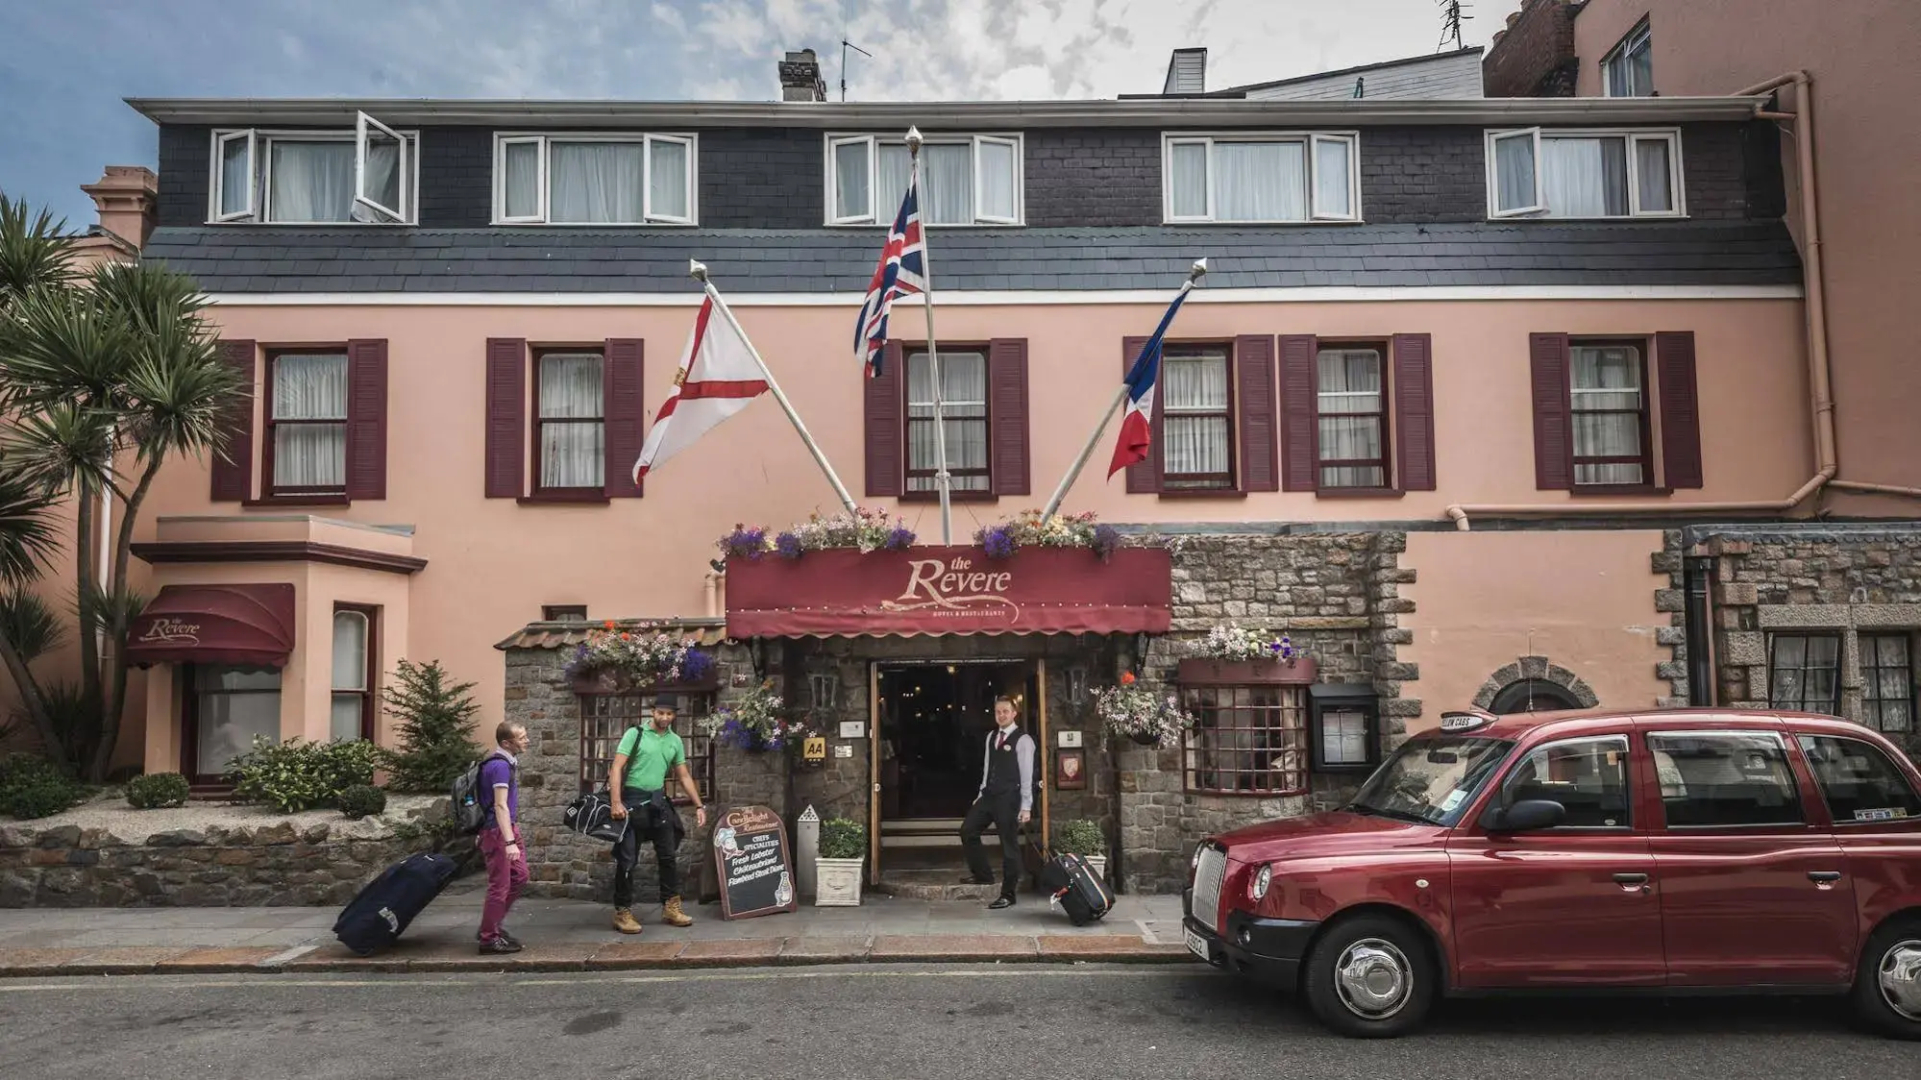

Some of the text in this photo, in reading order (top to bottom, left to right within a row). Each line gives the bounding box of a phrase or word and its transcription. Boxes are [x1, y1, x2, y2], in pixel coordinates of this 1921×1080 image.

[951, 556, 972, 570] the
[897, 559, 1012, 609] Revere
[145, 618, 200, 641] Revere
[807, 743, 822, 755] AA
[732, 848, 776, 867] Fresh Lobster
